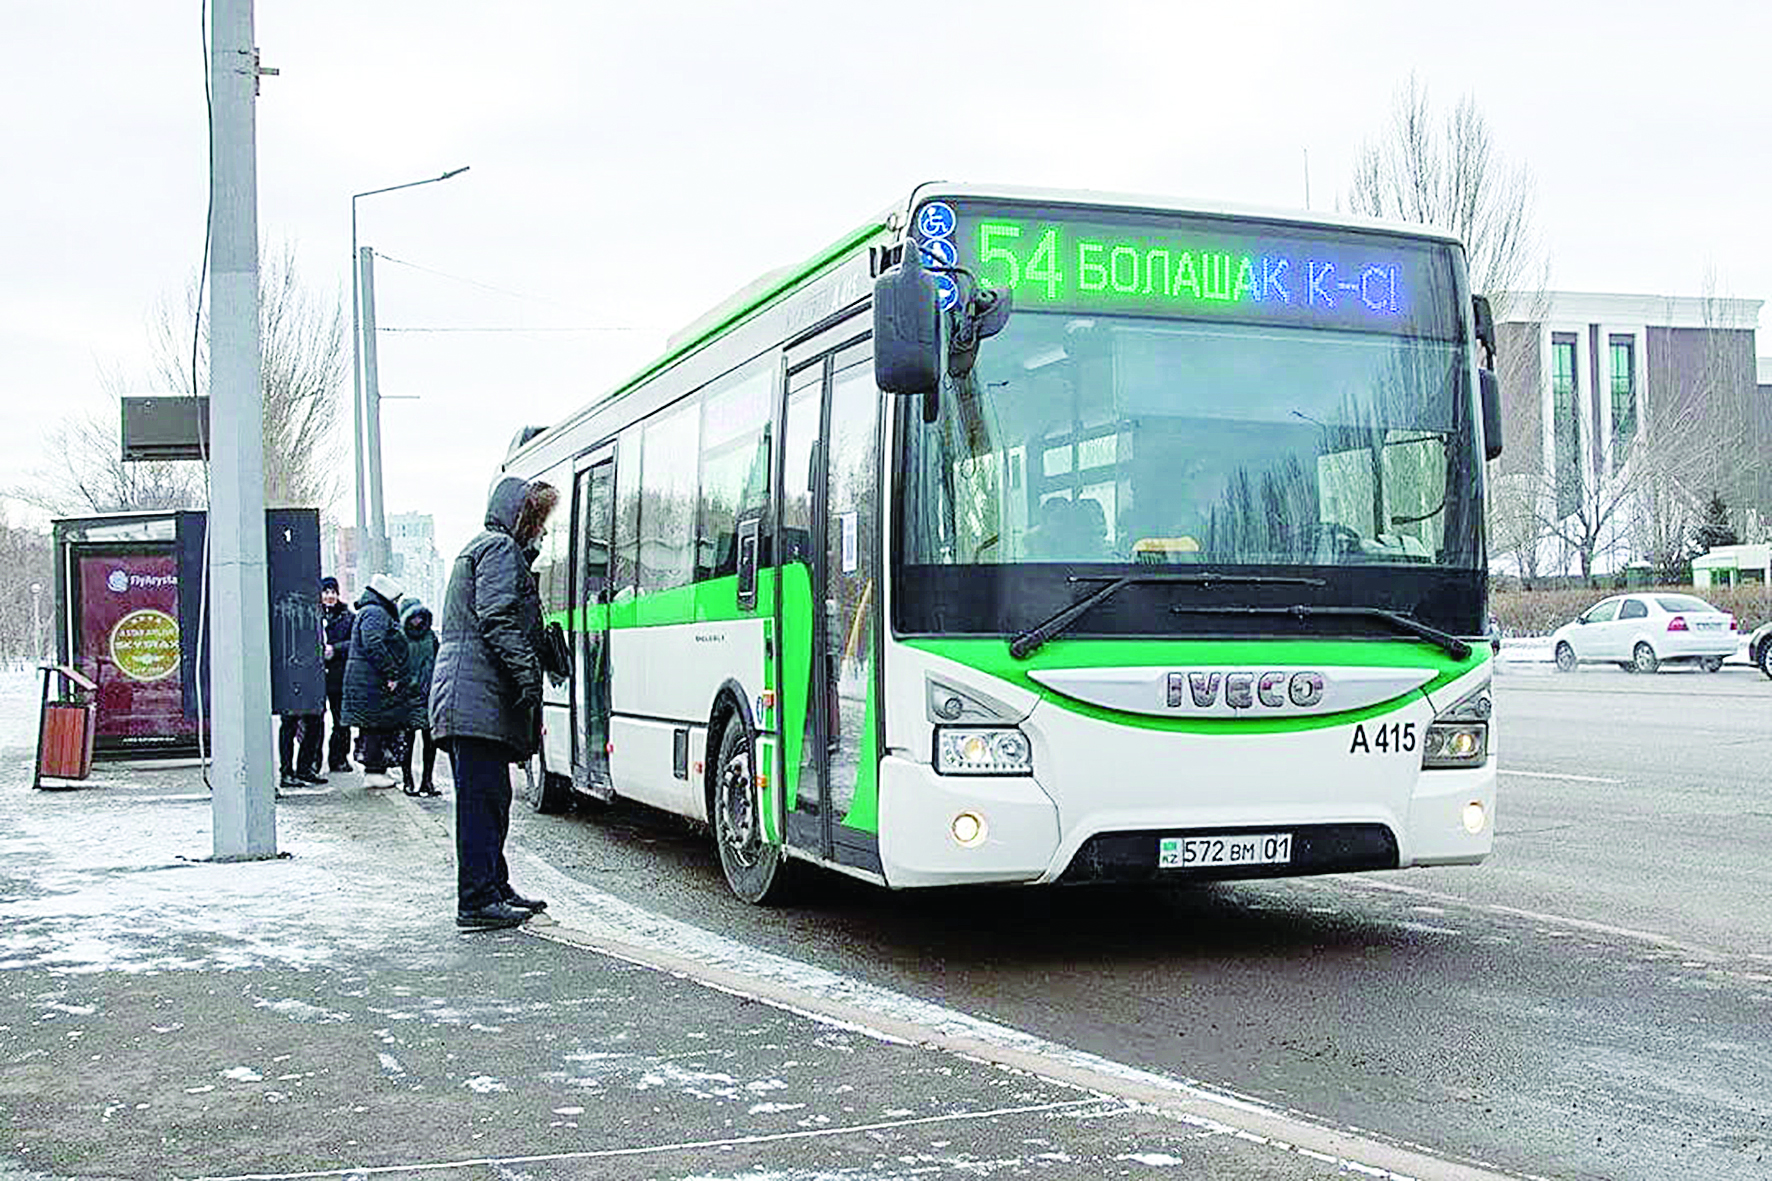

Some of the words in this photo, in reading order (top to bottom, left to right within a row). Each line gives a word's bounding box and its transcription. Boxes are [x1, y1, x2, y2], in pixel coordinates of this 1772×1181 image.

[980, 223, 1062, 299] 54
[1079, 242, 1291, 302] БОЛАШАК
[130, 574, 179, 589] FlyArysta
[1166, 671, 1324, 709] IVECO
[1350, 724, 1370, 753] A
[1375, 722, 1416, 753] 415
[1183, 840, 1225, 862] 572
[1230, 843, 1255, 861] BM
[1264, 837, 1289, 860] 01
